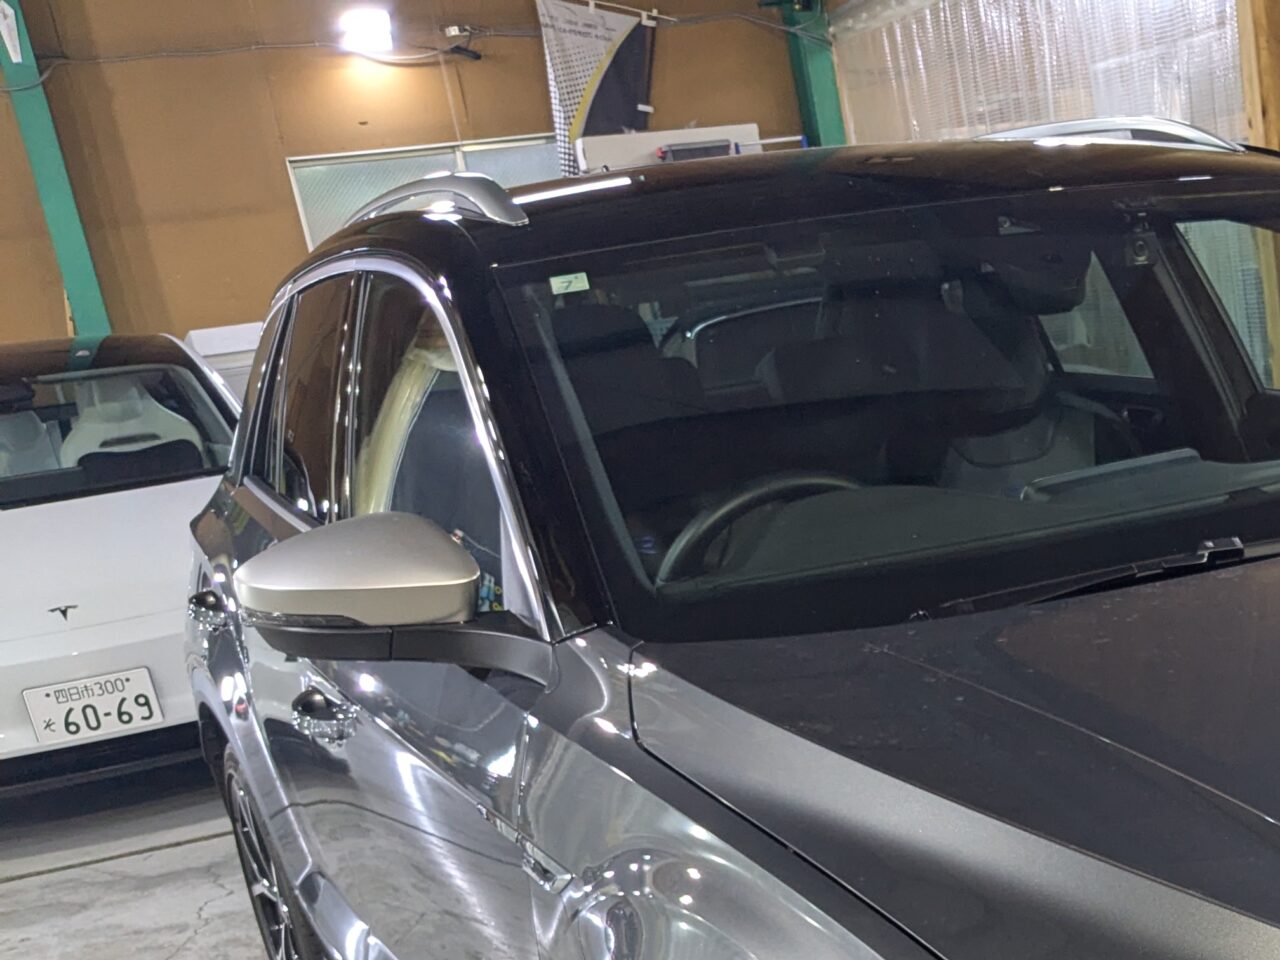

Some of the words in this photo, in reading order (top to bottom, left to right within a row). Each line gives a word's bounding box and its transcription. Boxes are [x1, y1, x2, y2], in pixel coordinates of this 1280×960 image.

[53, 677, 126, 705] 四日市300
[63, 693, 154, 736] 60-69
